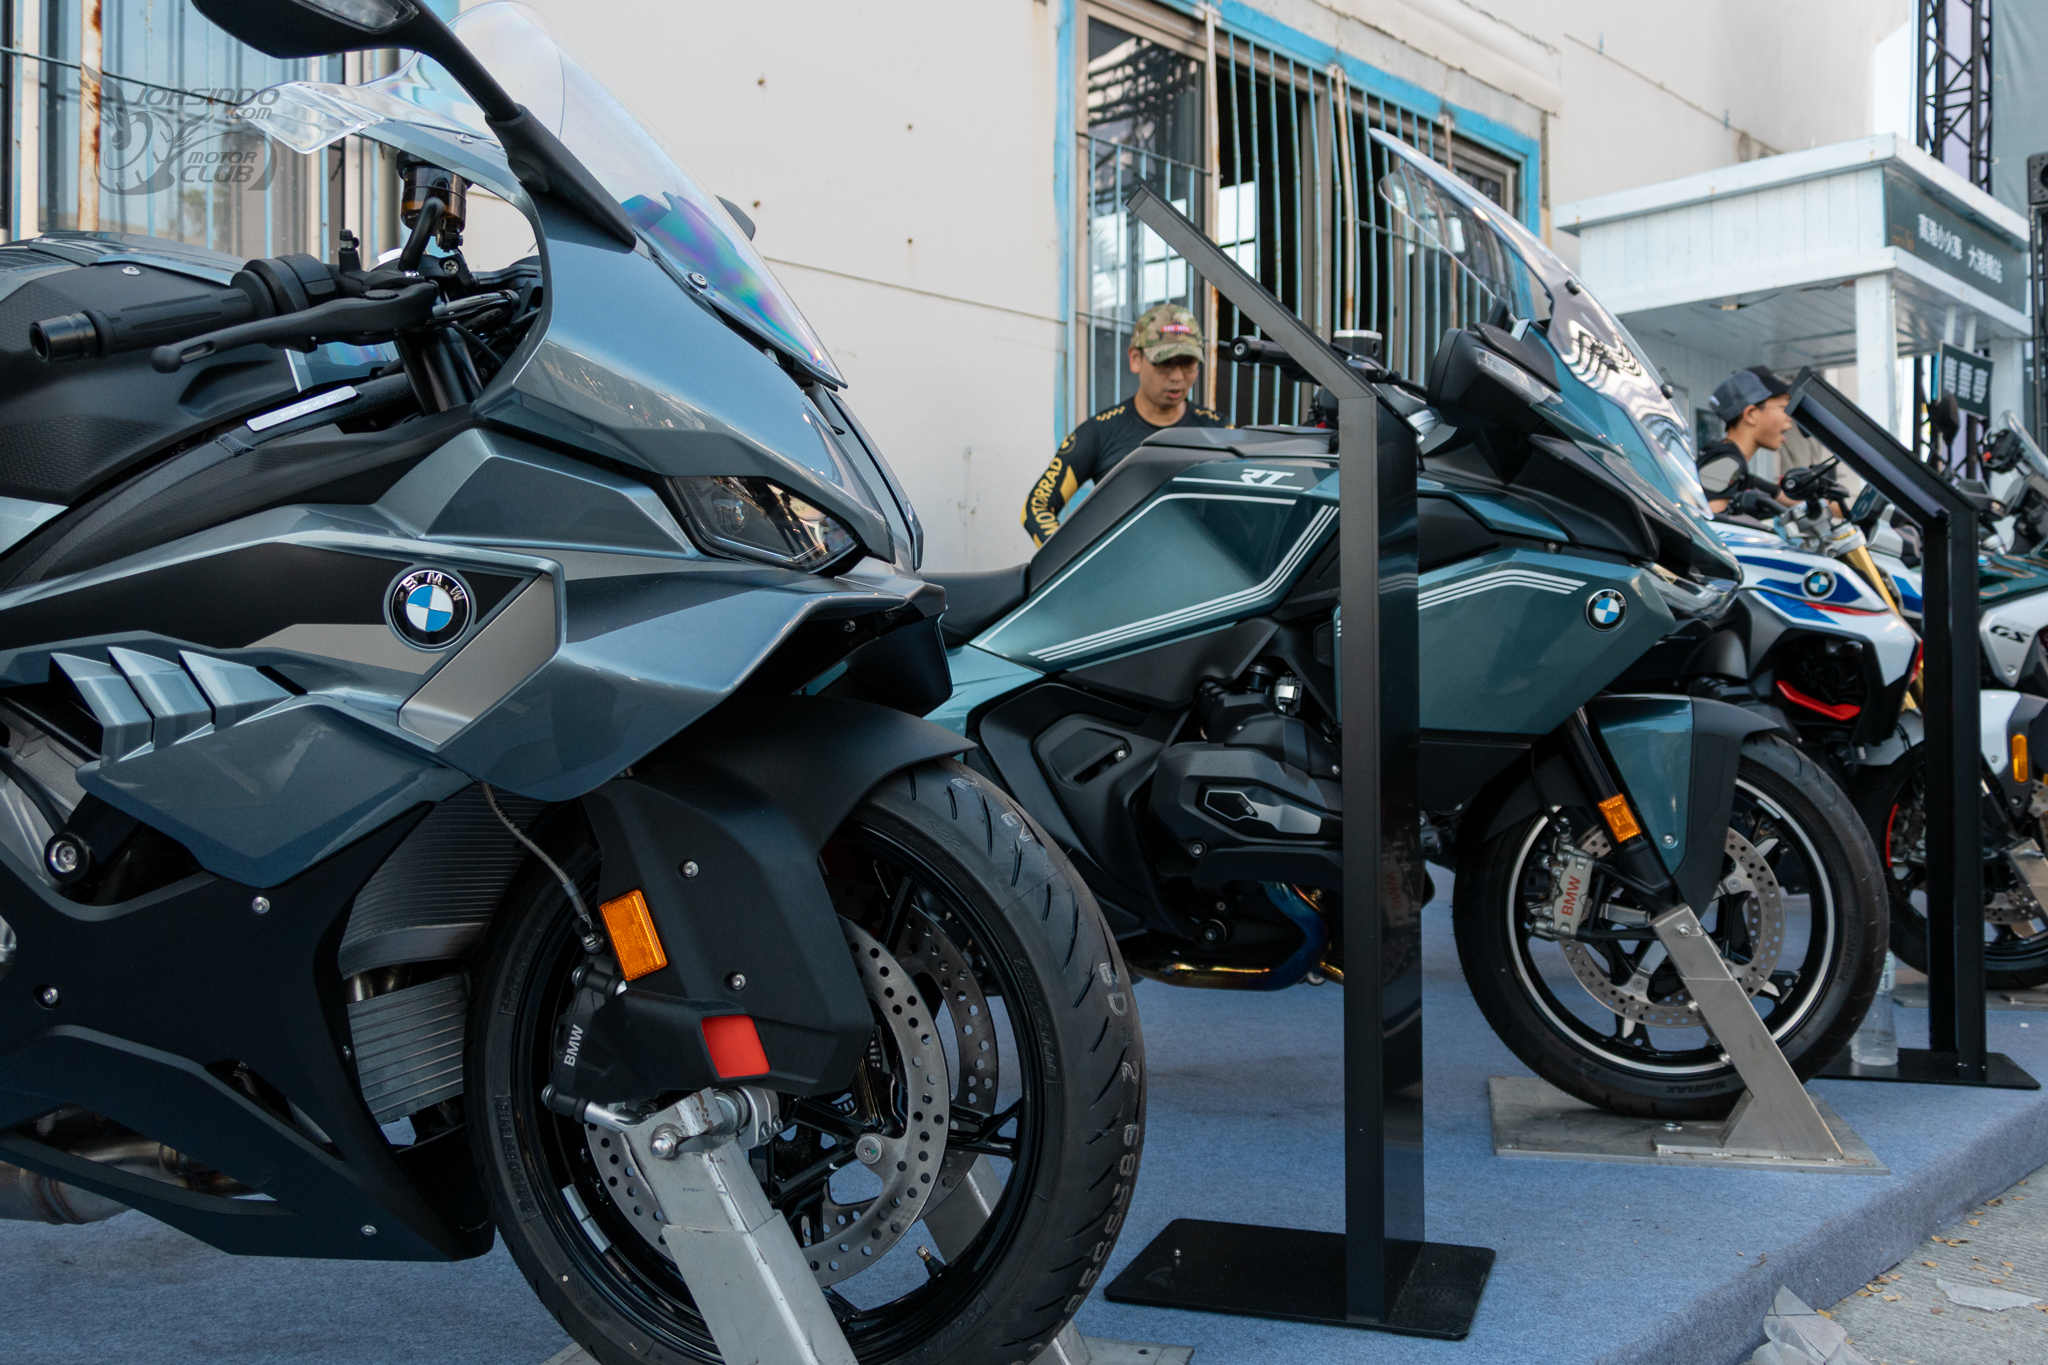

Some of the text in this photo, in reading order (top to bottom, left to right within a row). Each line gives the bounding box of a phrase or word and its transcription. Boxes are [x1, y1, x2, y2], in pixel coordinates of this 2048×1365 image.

[1240, 468, 1296, 486] RT
[1030, 456, 1063, 537] MOTORRAD
[402, 572, 465, 602] BMW
[1990, 625, 2031, 644] GS
[1561, 875, 1582, 917] BMW
[563, 1023, 584, 1067] BMW
